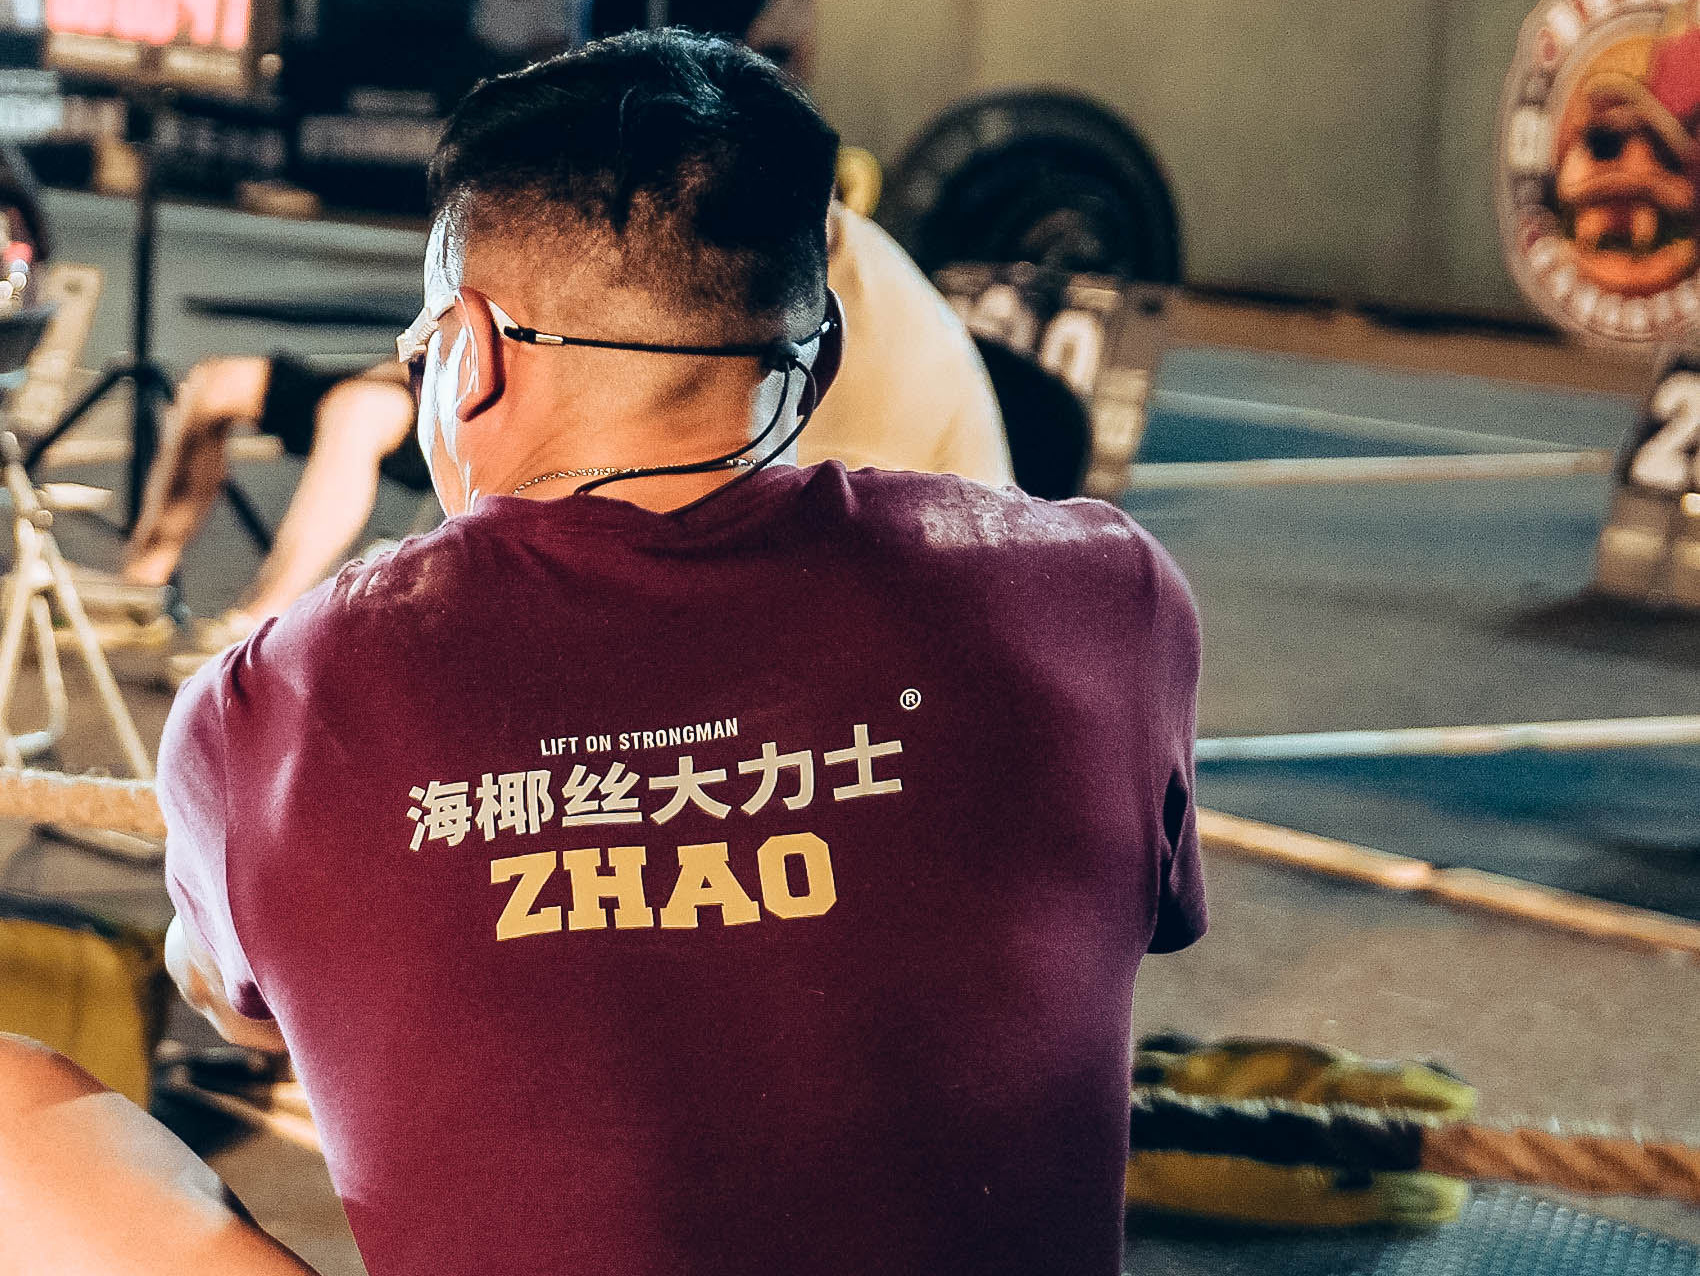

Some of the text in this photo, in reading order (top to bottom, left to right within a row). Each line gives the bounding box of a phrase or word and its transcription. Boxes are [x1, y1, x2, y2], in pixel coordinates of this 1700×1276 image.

[406, 724, 903, 851] 海椰丝大力士
[540, 717, 739, 756] LIFT ON STRONGMAN
[490, 831, 837, 941] ZHAO
